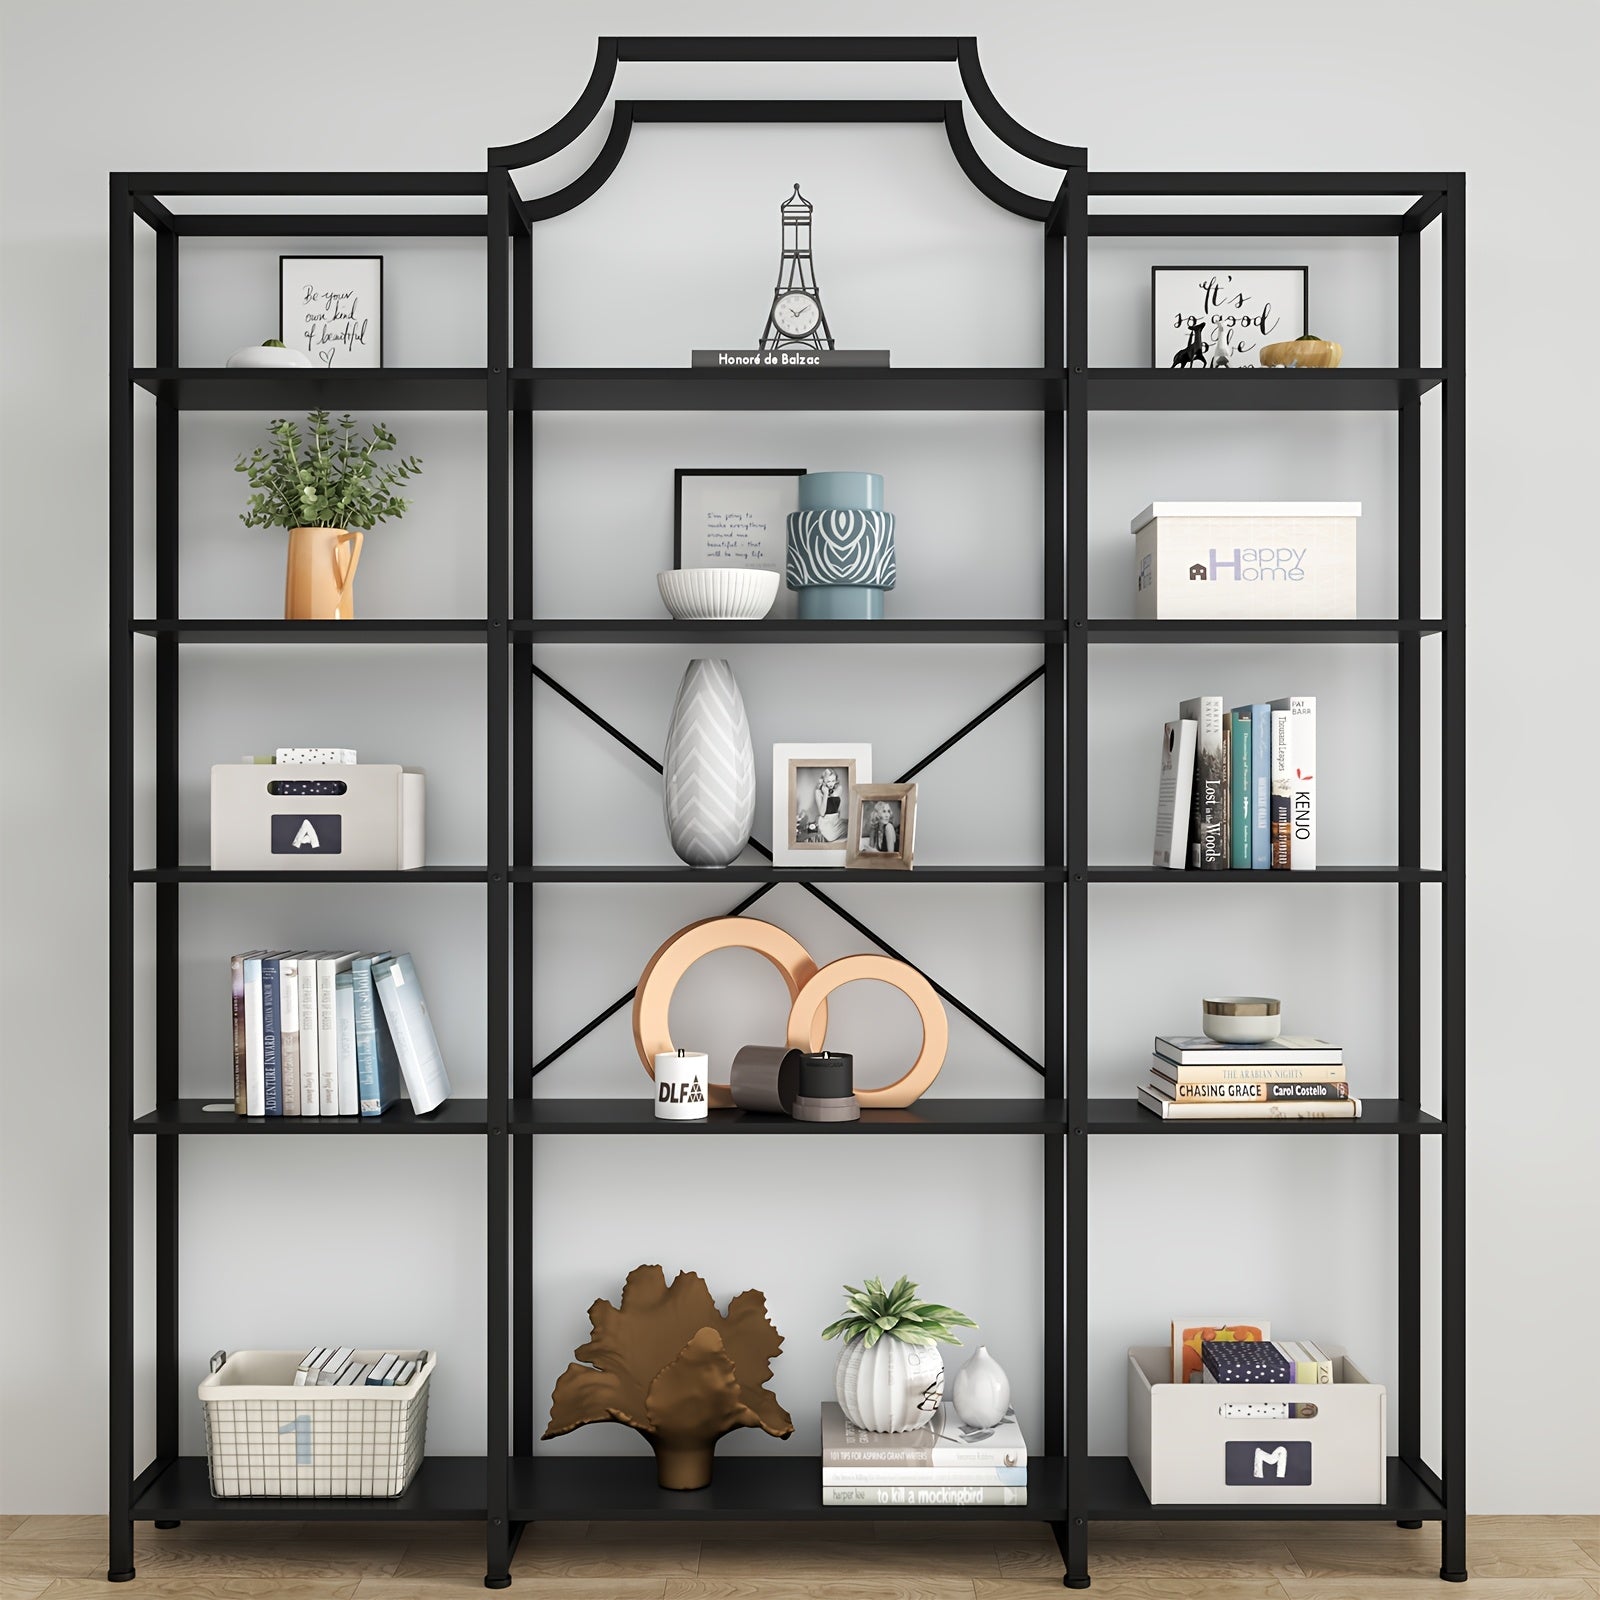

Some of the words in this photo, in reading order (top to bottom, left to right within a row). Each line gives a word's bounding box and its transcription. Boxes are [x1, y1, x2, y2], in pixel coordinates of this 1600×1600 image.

[303, 284, 318, 305] Be
[321, 290, 353, 311] your
[1199, 275, 1252, 315] It's
[305, 313, 325, 323] own
[326, 297, 358, 324] kind
[304, 323, 316, 352] of
[316, 318, 368, 352] beautiful
[719, 352, 760, 365] Honoré
[764, 352, 778, 365] de
[781, 352, 820, 365] Balzac
[1278, 716, 1286, 746] Thousand
[1205, 780, 1220, 805] Lost
[1295, 791, 1310, 840] KENJO
[292, 818, 320, 849] A
[1205, 822, 1221, 862] Woods
[264, 1035, 276, 1065] INWARD
[1223, 1069, 1237, 1079] THE
[1239, 1069, 1272, 1079] ARABIAN
[1274, 1069, 1303, 1079] NIGHTS
[264, 1067, 277, 1112] ADVENTURE
[1179, 1084, 1225, 1097] CHASING
[1228, 1084, 1262, 1097] GRACE
[1273, 1084, 1293, 1096] Carol
[1295, 1084, 1327, 1096] Costello
[278, 1414, 312, 1465] 1
[851, 1451, 862, 1461] FOR
[1253, 1446, 1287, 1479] M
[877, 1488, 889, 1504] to
[891, 1486, 905, 1504] kill
[908, 1490, 915, 1504] a
[918, 1486, 984, 1506] mockingbird
